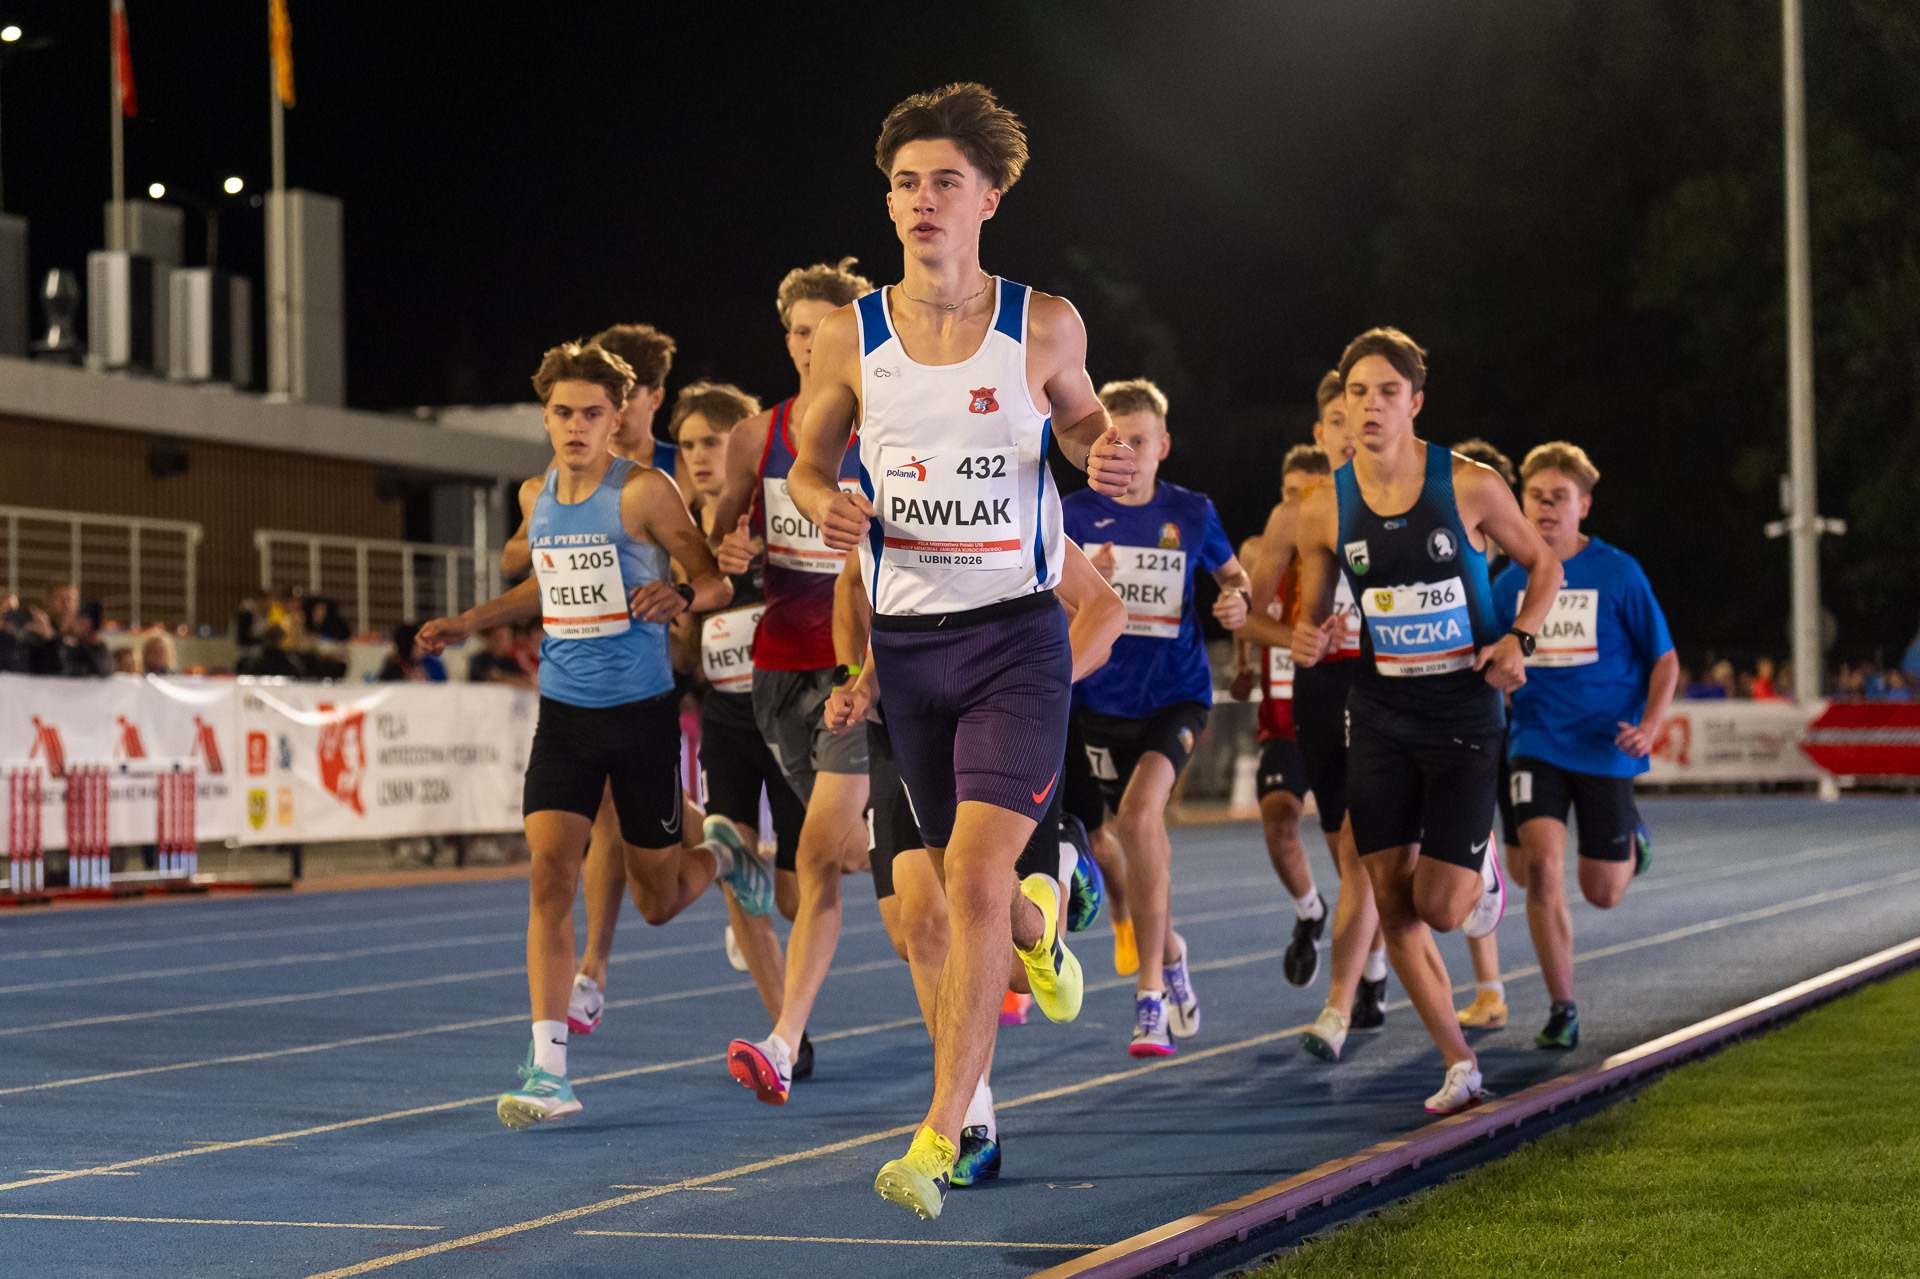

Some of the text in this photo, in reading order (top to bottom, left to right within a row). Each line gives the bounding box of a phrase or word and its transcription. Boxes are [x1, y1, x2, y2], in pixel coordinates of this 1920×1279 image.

[886, 469, 917, 479] polanik
[956, 454, 1007, 480] 432
[891, 496, 1012, 526] PAWLAK
[554, 533, 609, 545] PYRZYCE
[568, 550, 614, 571] 1205
[919, 554, 983, 565] LUBIN 2026
[1136, 553, 1181, 573] 1214
[549, 583, 608, 606] CIELEK
[1416, 586, 1455, 609] 786
[1558, 594, 1589, 609] 972
[581, 626, 601, 634] 2026
[1374, 618, 1462, 646] TYCZKA
[1089, 750, 1103, 775] 7
